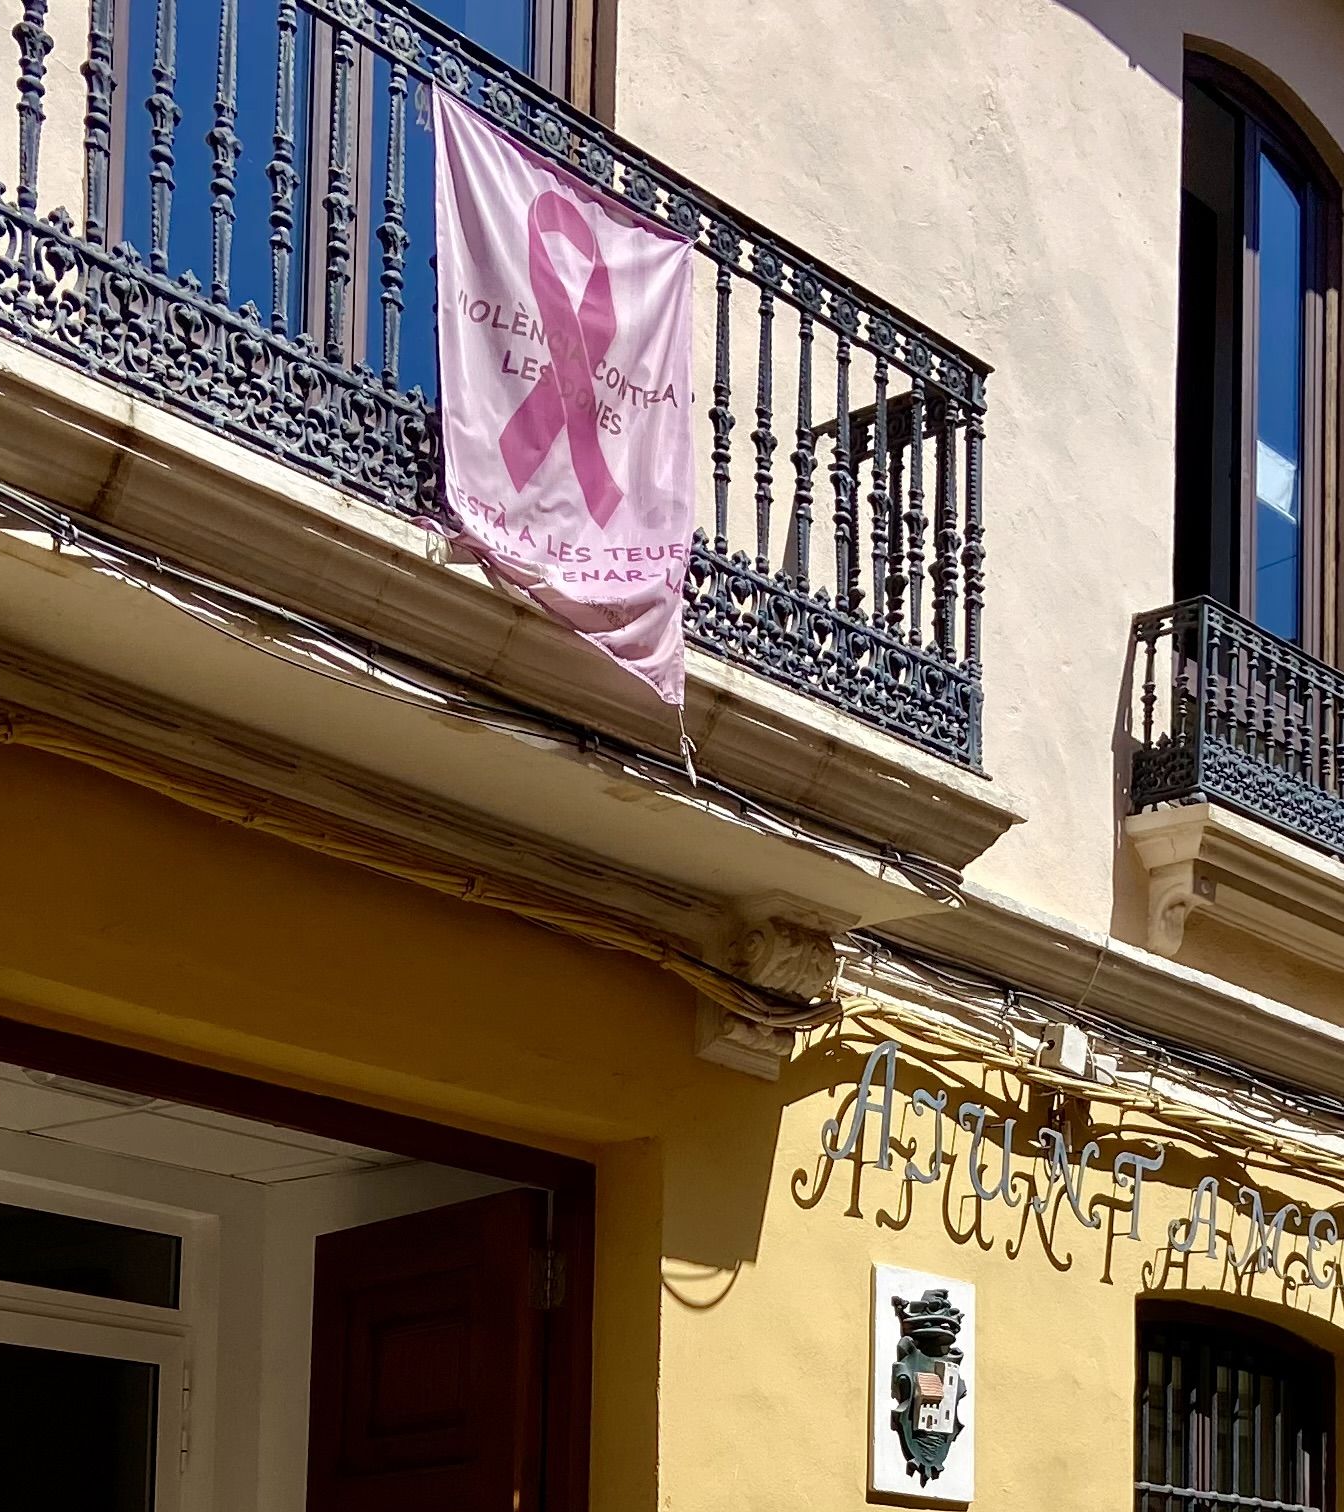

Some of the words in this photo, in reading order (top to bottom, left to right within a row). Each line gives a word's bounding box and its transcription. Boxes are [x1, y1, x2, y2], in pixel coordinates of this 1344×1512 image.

[501, 349, 554, 387] LES
[593, 358, 679, 410] CONTRA
[457, 487, 510, 536] ESTÀ
[518, 525, 536, 548] A
[547, 534, 592, 563] LES
